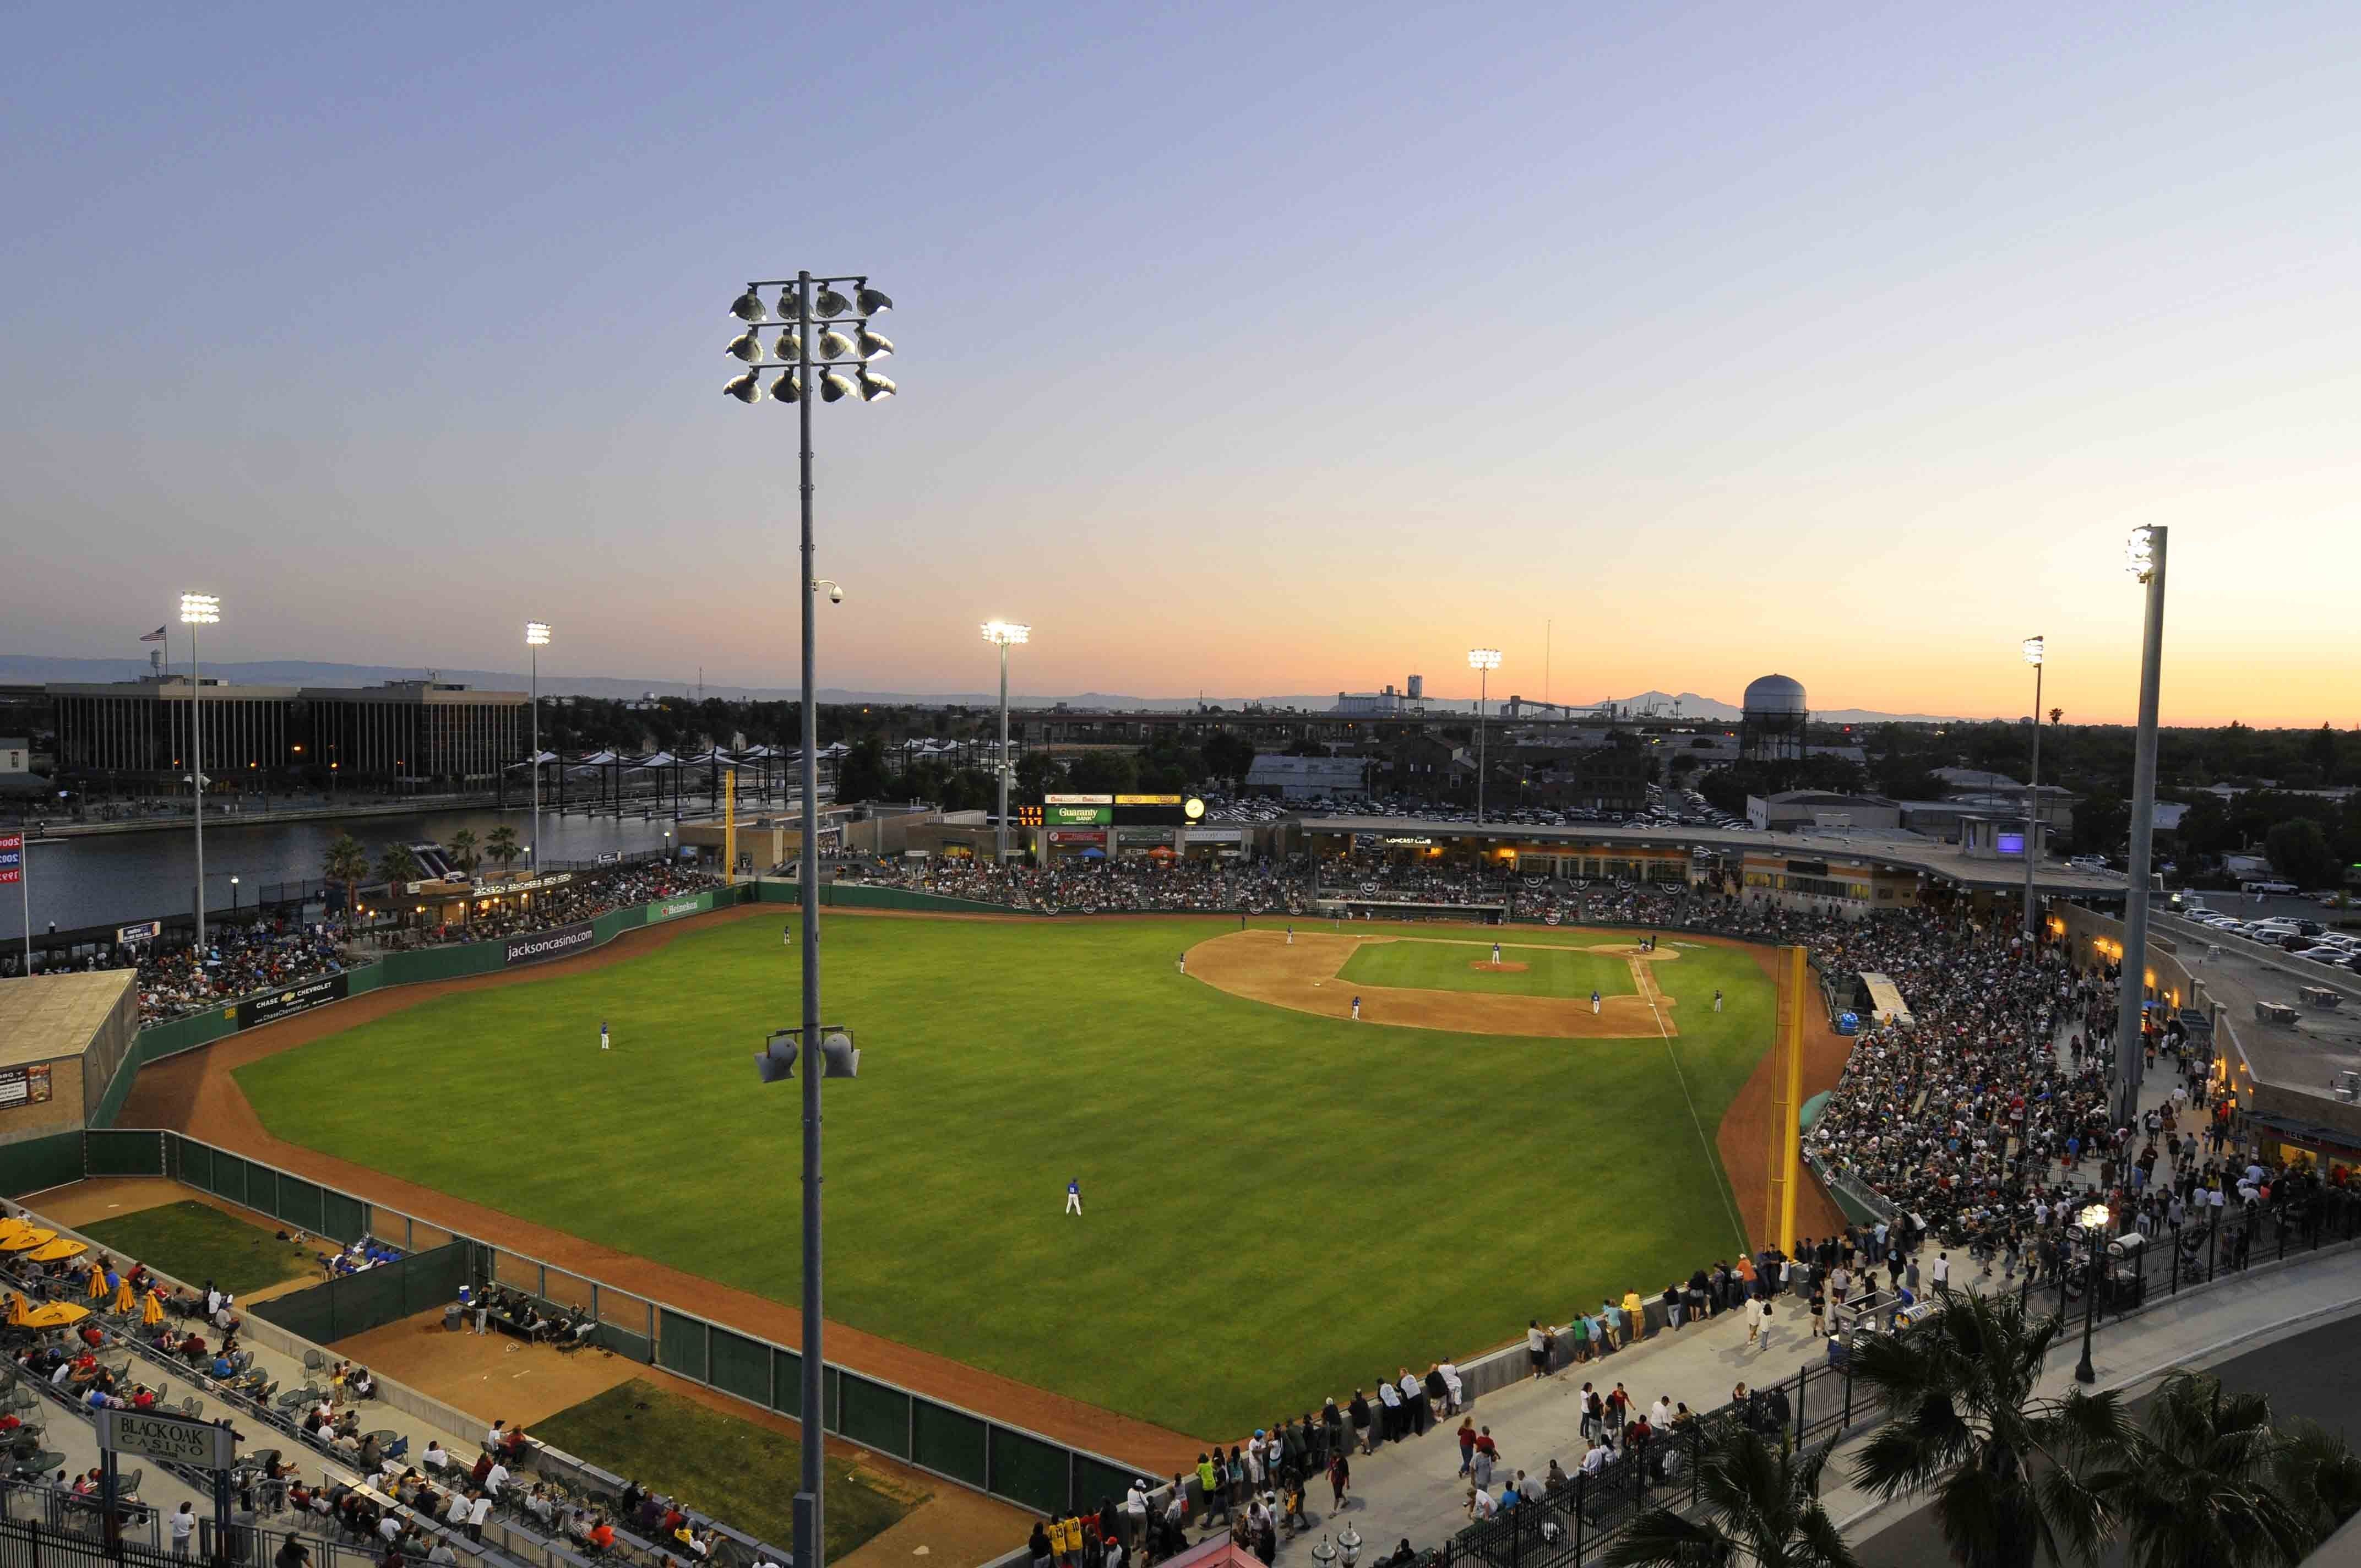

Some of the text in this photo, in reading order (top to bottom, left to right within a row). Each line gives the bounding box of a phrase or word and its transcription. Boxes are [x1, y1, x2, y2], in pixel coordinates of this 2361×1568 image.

[1059, 808, 1098, 819] Guaranty
[474, 885, 506, 895] JACKSON
[668, 901, 698, 914] Heineken
[507, 929, 593, 962] jacksoncasino.com
[255, 982, 332, 1009] CHASE CHEVROLET
[121, 1417, 204, 1446] BLACK OAK
[121, 1434, 204, 1457] CASINO
